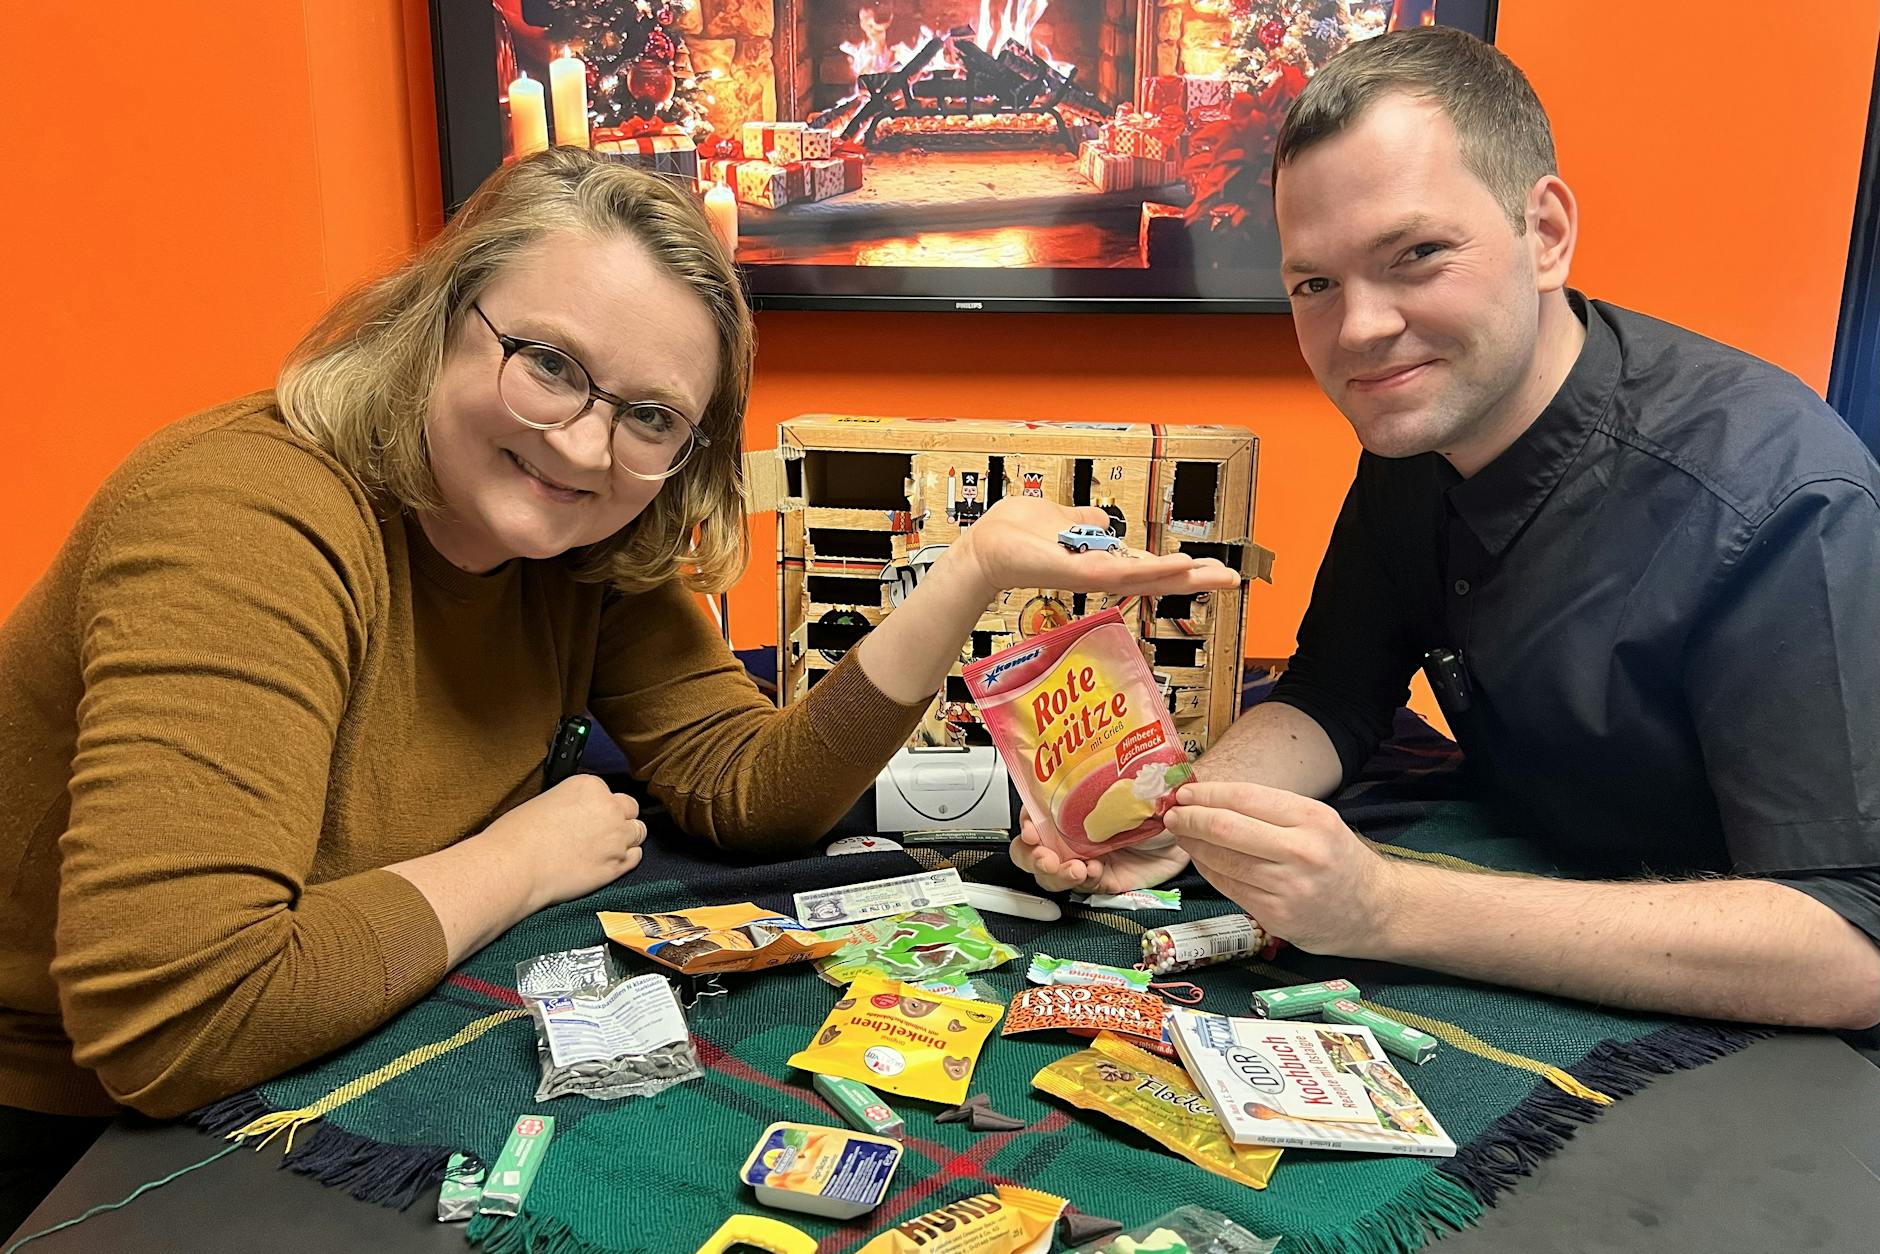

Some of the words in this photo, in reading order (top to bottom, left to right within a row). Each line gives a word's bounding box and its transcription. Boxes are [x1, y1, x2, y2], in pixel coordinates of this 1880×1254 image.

[1110, 464, 1123, 480] 13
[1003, 592, 1011, 605] 7
[1100, 597, 1108, 610] 2
[1032, 666, 1096, 736] Rote
[1191, 695, 1199, 708] 4
[1034, 692, 1128, 782] Grütze
[1090, 737, 1102, 751] mit
[1104, 721, 1124, 740] Grieß
[1122, 727, 1158, 748] Himbeer-
[1184, 739, 1198, 753] 12
[1120, 735, 1162, 764] Geschmack
[1021, 988, 1092, 1009] OSSI
[1033, 1004, 1142, 1022] KNUSPRIG
[850, 1016, 947, 1050] Dinkelchen
[1299, 1035, 1325, 1065] Ostalgie
[1233, 1053, 1279, 1087] DDR
[1261, 1036, 1333, 1106] Kochbuch
[1321, 1066, 1333, 1079] mit
[1327, 1079, 1358, 1109] Rezepte
